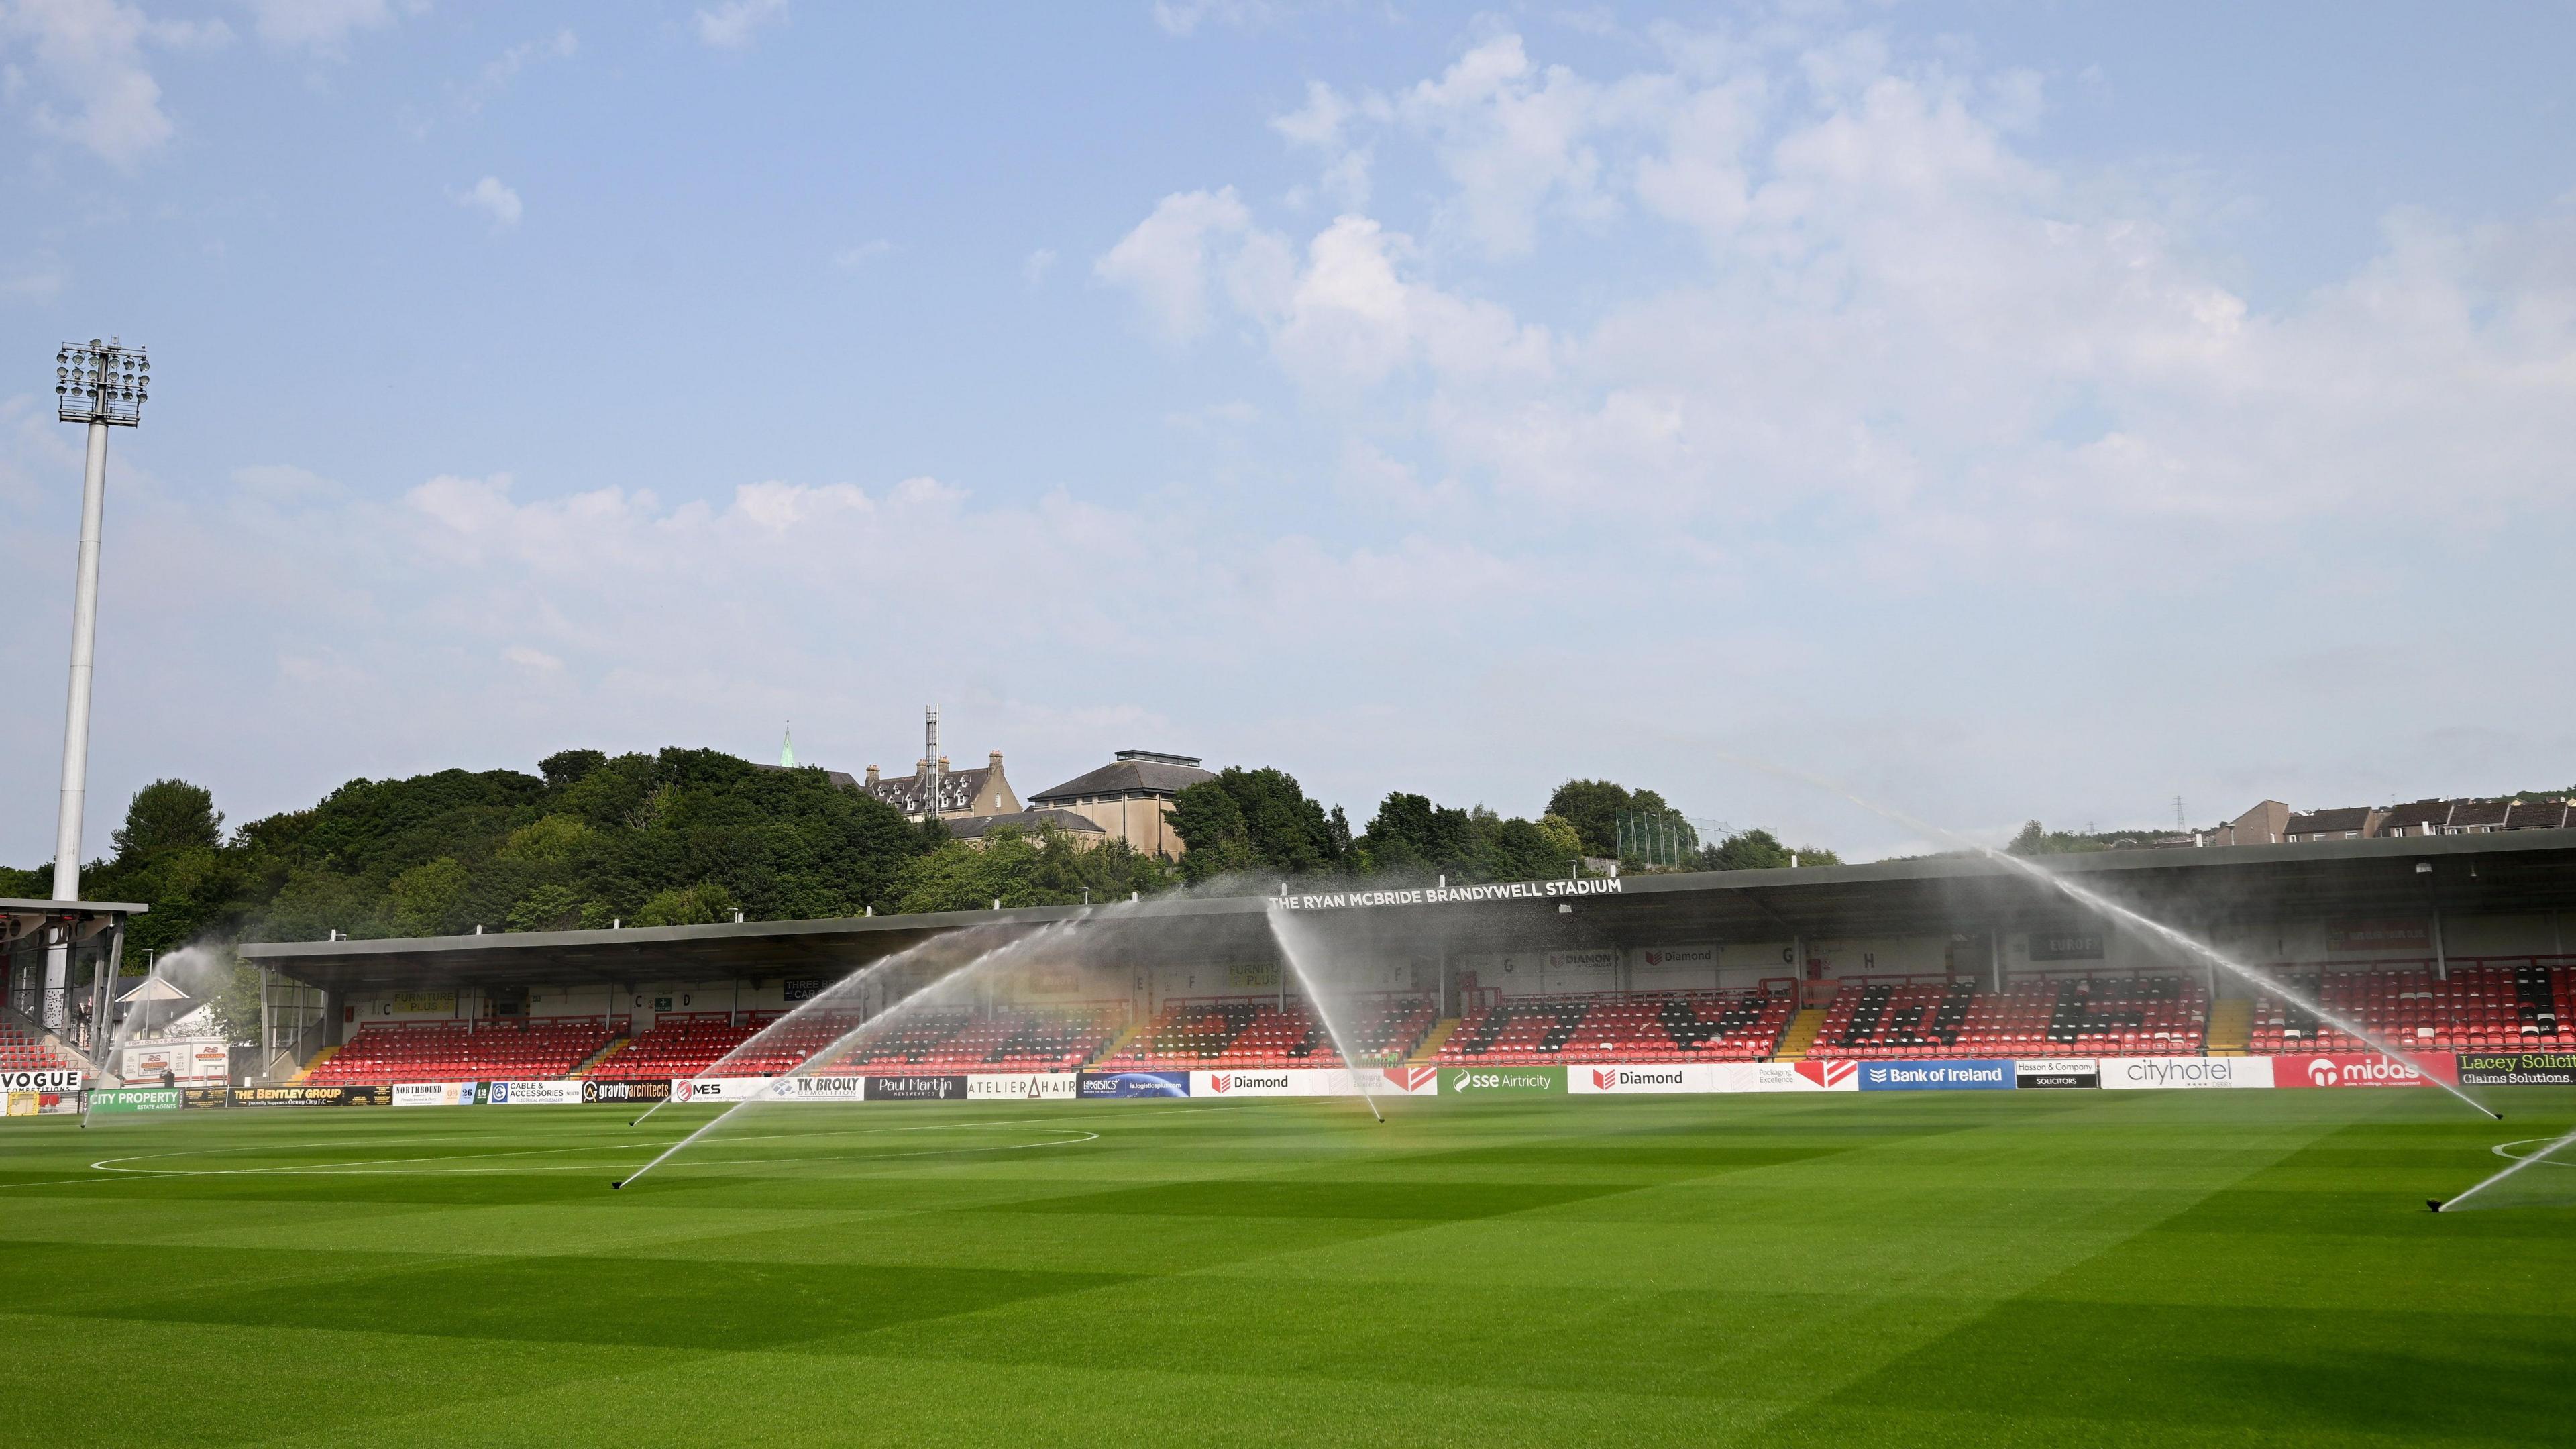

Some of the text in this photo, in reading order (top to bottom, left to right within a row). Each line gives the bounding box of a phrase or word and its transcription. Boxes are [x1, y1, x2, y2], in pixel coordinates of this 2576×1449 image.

[1269, 879, 1621, 909] THE RYAN MCBRIDE BRANDYWELL STADIUM
[1666, 951, 1711, 961] Diamond
[1782, 947, 1793, 963] G
[1864, 953, 1874, 968] H
[1229, 964, 1279, 975] FURNITU
[1504, 959, 1513, 972] G
[786, 981, 819, 989] THREE
[1138, 977, 1143, 989] E
[1190, 975, 1195, 988] F
[1246, 975, 1277, 985] PLUS
[394, 993, 454, 1002] FURNITURE
[684, 994, 690, 1006] D
[794, 990, 816, 998] CAR
[635, 995, 642, 1007] C
[384, 1004, 390, 1015] C
[2048, 1063, 2054, 1071] &
[2055, 1063, 2093, 1072] Company
[2343, 1055, 2420, 1079] midas
[2460, 1055, 2518, 1072] Lacey
[1620, 1071, 1683, 1085] Diamond
[1759, 1069, 1792, 1077] Packaging
[1890, 1068, 2002, 1082] Bank of Ireland
[2127, 1059, 2231, 1085] cityhotel
[1, 1072, 78, 1087] VOGUE
[797, 1077, 859, 1091] TK BROLLY
[879, 1077, 952, 1091] Paul Martin
[1234, 1075, 1288, 1088] Diamond
[1472, 1075, 1551, 1090] sse Airtricity
[2463, 1073, 2573, 1084] Claims Solutions.
[396, 1085, 442, 1094] NORTHBOUND
[478, 1088, 486, 1096] 12
[599, 1082, 669, 1099] gravityarchitects
[693, 1084, 721, 1095] MES
[968, 1081, 1026, 1093] ATELIER
[1042, 1081, 1075, 1092] HAIR
[90, 1093, 115, 1104] CITY
[119, 1092, 178, 1104] PROPERTY
[235, 1090, 254, 1099] THE
[256, 1089, 304, 1099] BENTLEY
[305, 1089, 341, 1099] GROUP
[462, 1089, 472, 1097] 26
